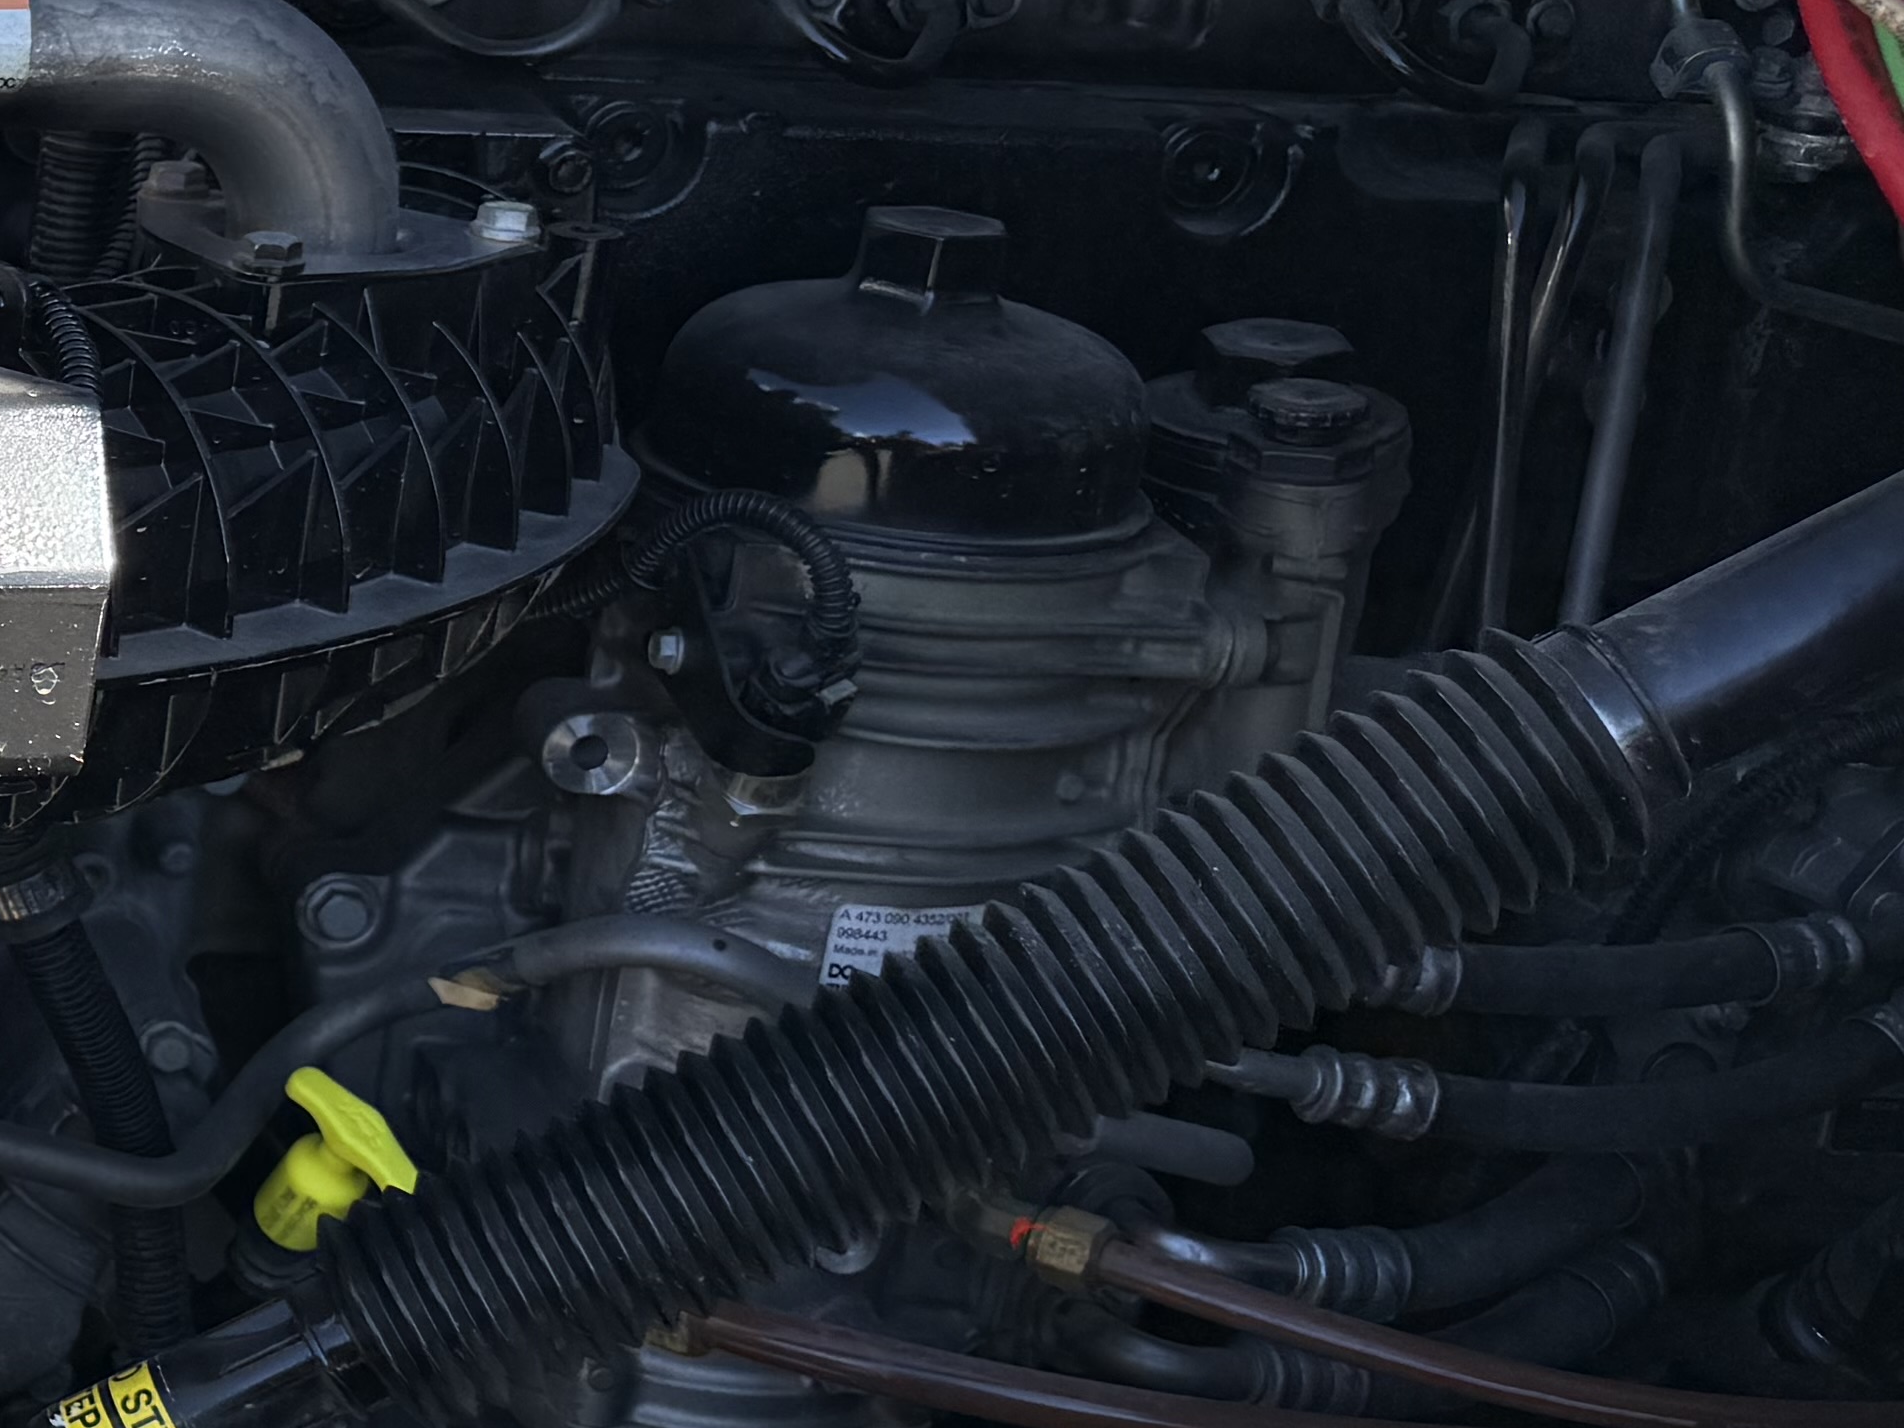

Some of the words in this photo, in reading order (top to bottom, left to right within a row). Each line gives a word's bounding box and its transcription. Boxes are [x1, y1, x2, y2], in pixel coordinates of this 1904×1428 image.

[840, 910, 852, 921] A
[856, 912, 881, 923] 473
[64, 1394, 102, 1428] EP
